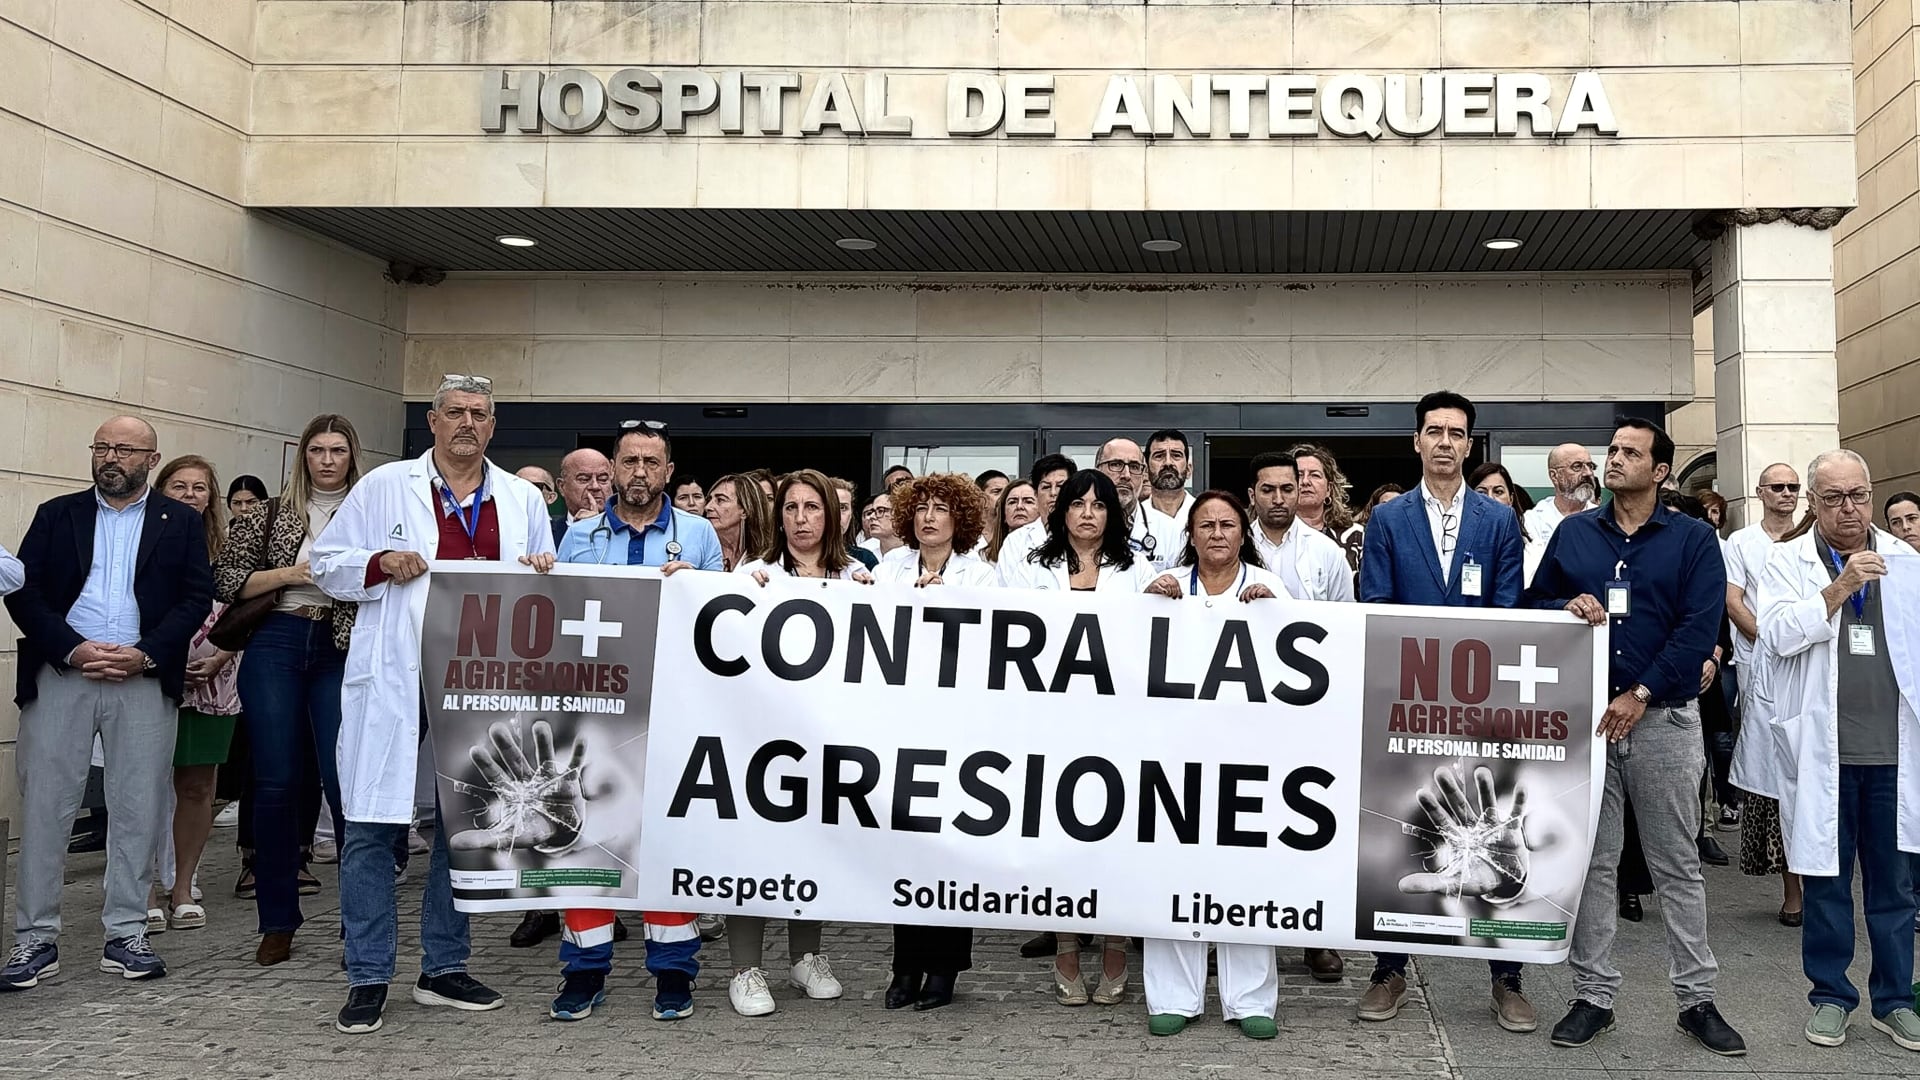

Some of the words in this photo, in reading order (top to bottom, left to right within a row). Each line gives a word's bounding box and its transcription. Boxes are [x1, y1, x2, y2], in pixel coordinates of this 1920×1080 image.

[481, 68, 912, 137] HOSPITAL
[946, 72, 1057, 138] DE
[1092, 70, 1620, 142] ANTEQUERA
[693, 593, 1116, 696] CONTRA
[1147, 616, 1330, 706] LAS
[443, 659, 629, 695] AGRESIONES
[442, 694, 461, 711] AL
[462, 694, 539, 713] PERSONAL
[541, 696, 561, 712] DE
[562, 697, 626, 715] SANIDAD
[1388, 702, 1569, 741] AGRESIONES
[1388, 737, 1406, 754] AL
[1408, 738, 1480, 758] PERSONAL
[1482, 742, 1500, 759] DE
[1501, 743, 1567, 762] SANIDAD
[666, 735, 1337, 851] AGRESIONES
[671, 868, 818, 906] Respeto
[892, 878, 1098, 919] Solidaridad
[1171, 892, 1324, 932] Libertad
